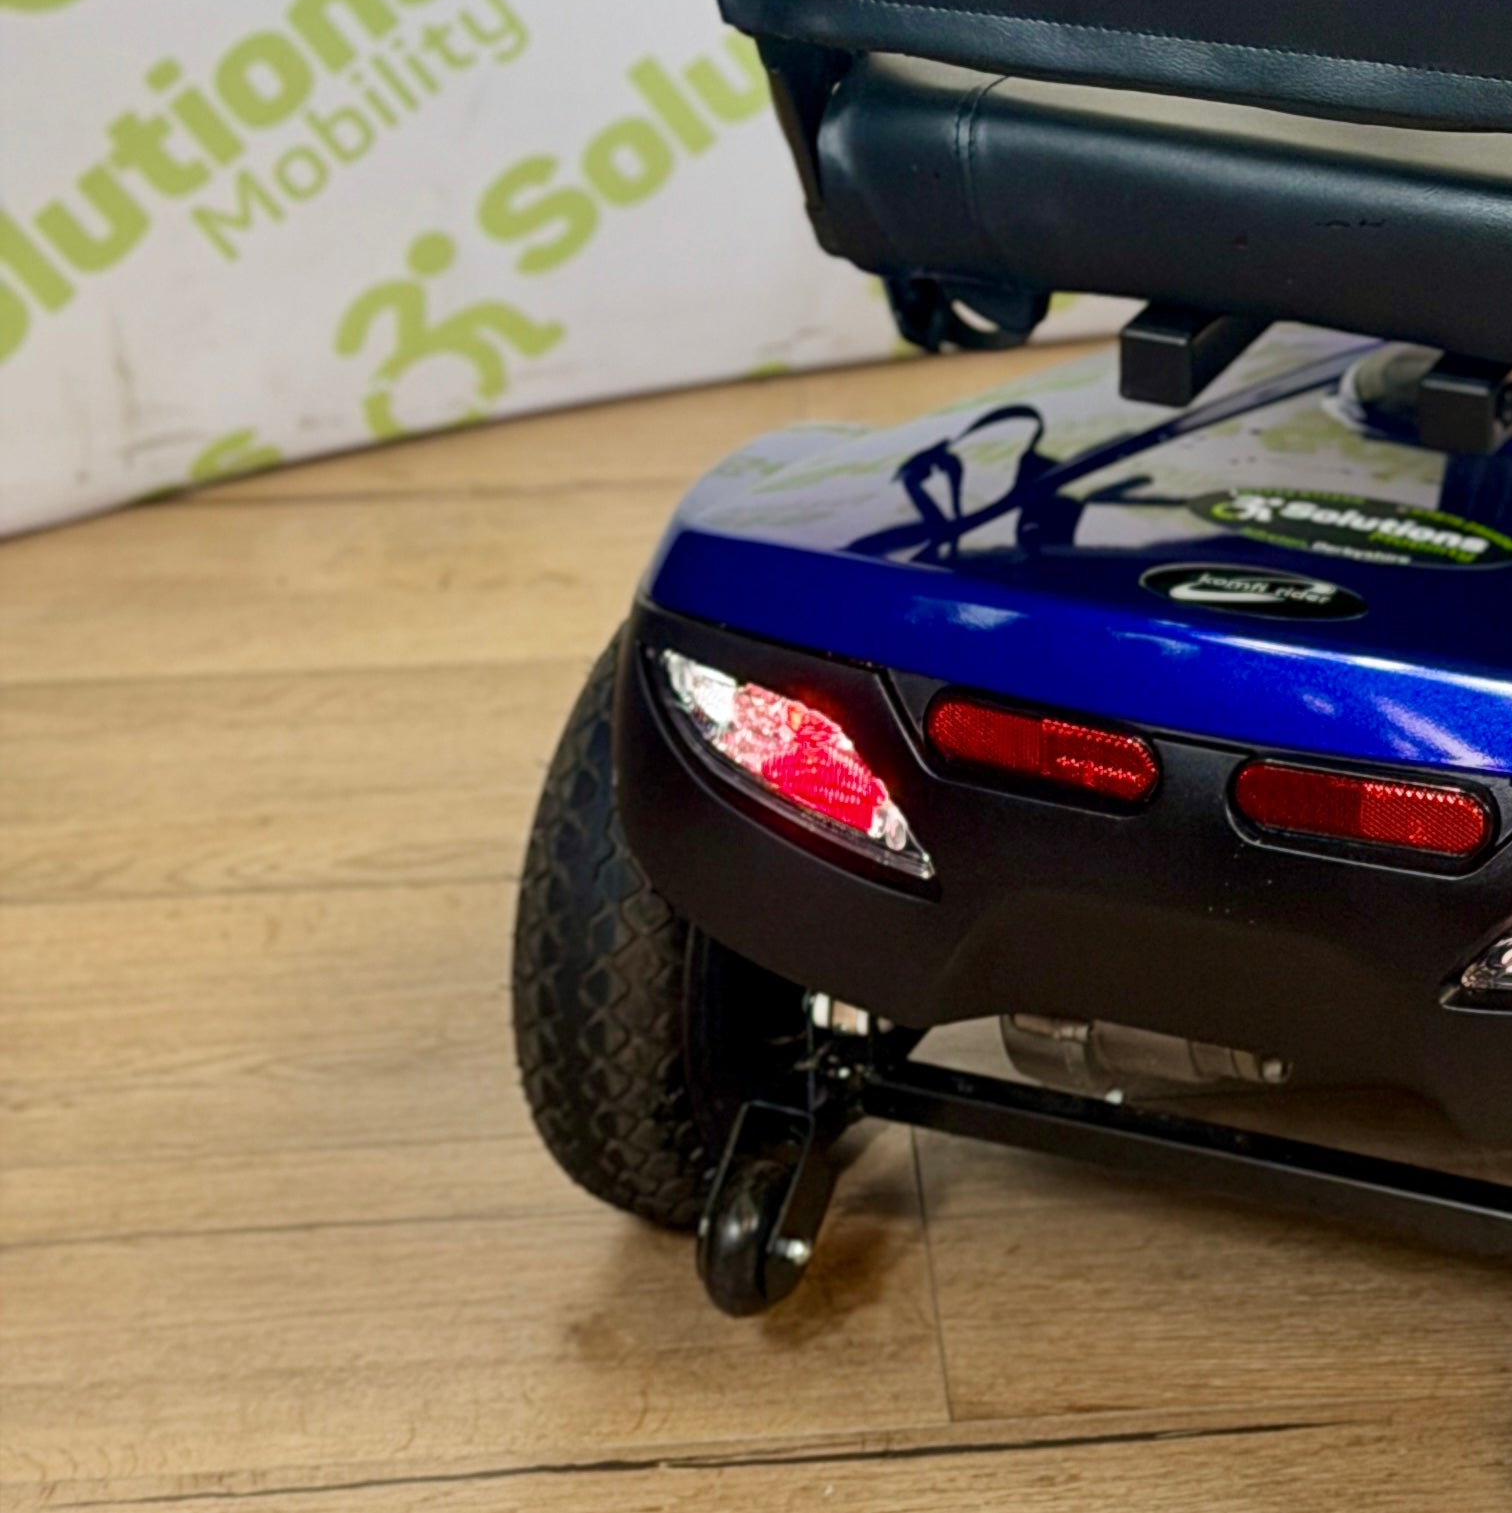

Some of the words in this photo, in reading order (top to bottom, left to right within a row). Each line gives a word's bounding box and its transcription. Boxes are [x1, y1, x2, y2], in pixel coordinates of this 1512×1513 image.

[1280, 501, 1490, 554] Solutions
[1198, 572, 1267, 594] komfi
[1274, 586, 1331, 605] rider
